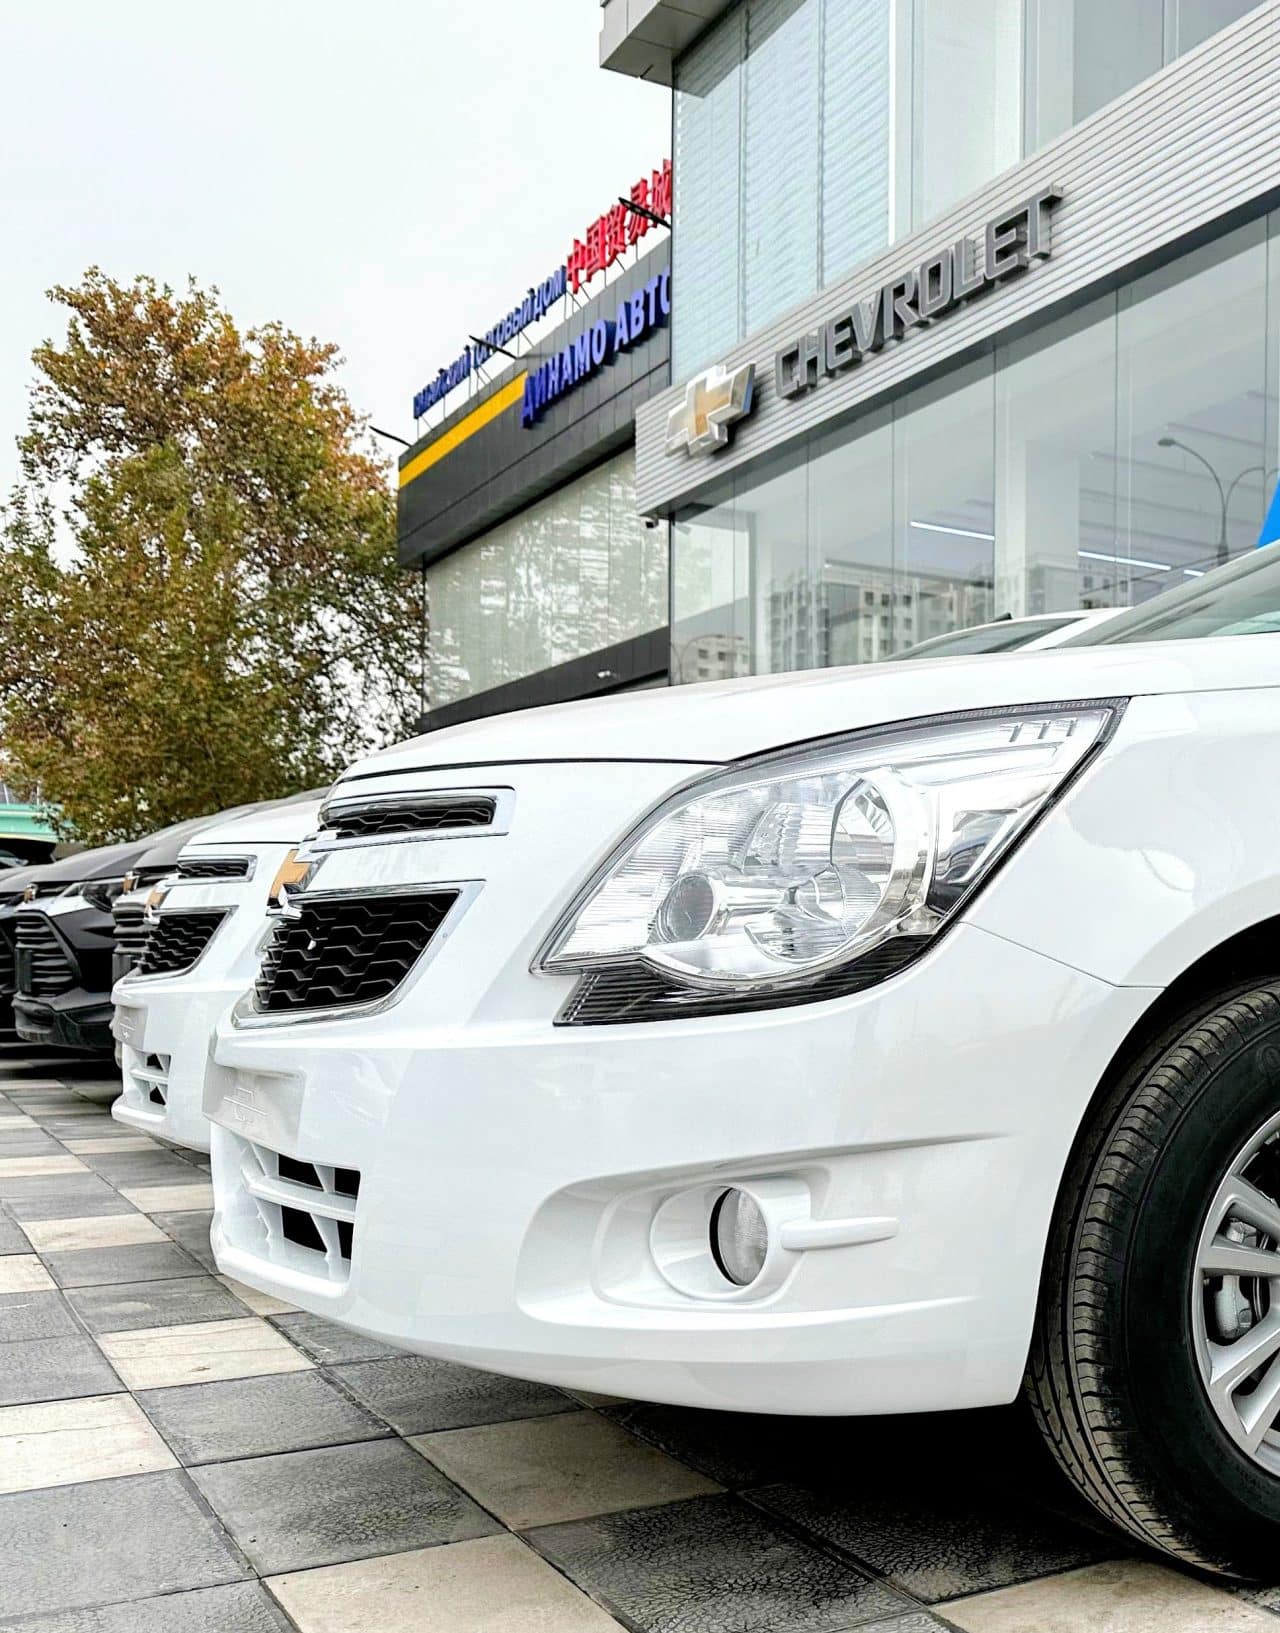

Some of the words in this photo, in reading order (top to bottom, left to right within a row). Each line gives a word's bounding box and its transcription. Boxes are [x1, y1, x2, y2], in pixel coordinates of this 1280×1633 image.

[532, 264, 568, 323] ДОМ
[775, 183, 1063, 400] CHEVROLET
[520, 319, 612, 429] ДИНАМО
